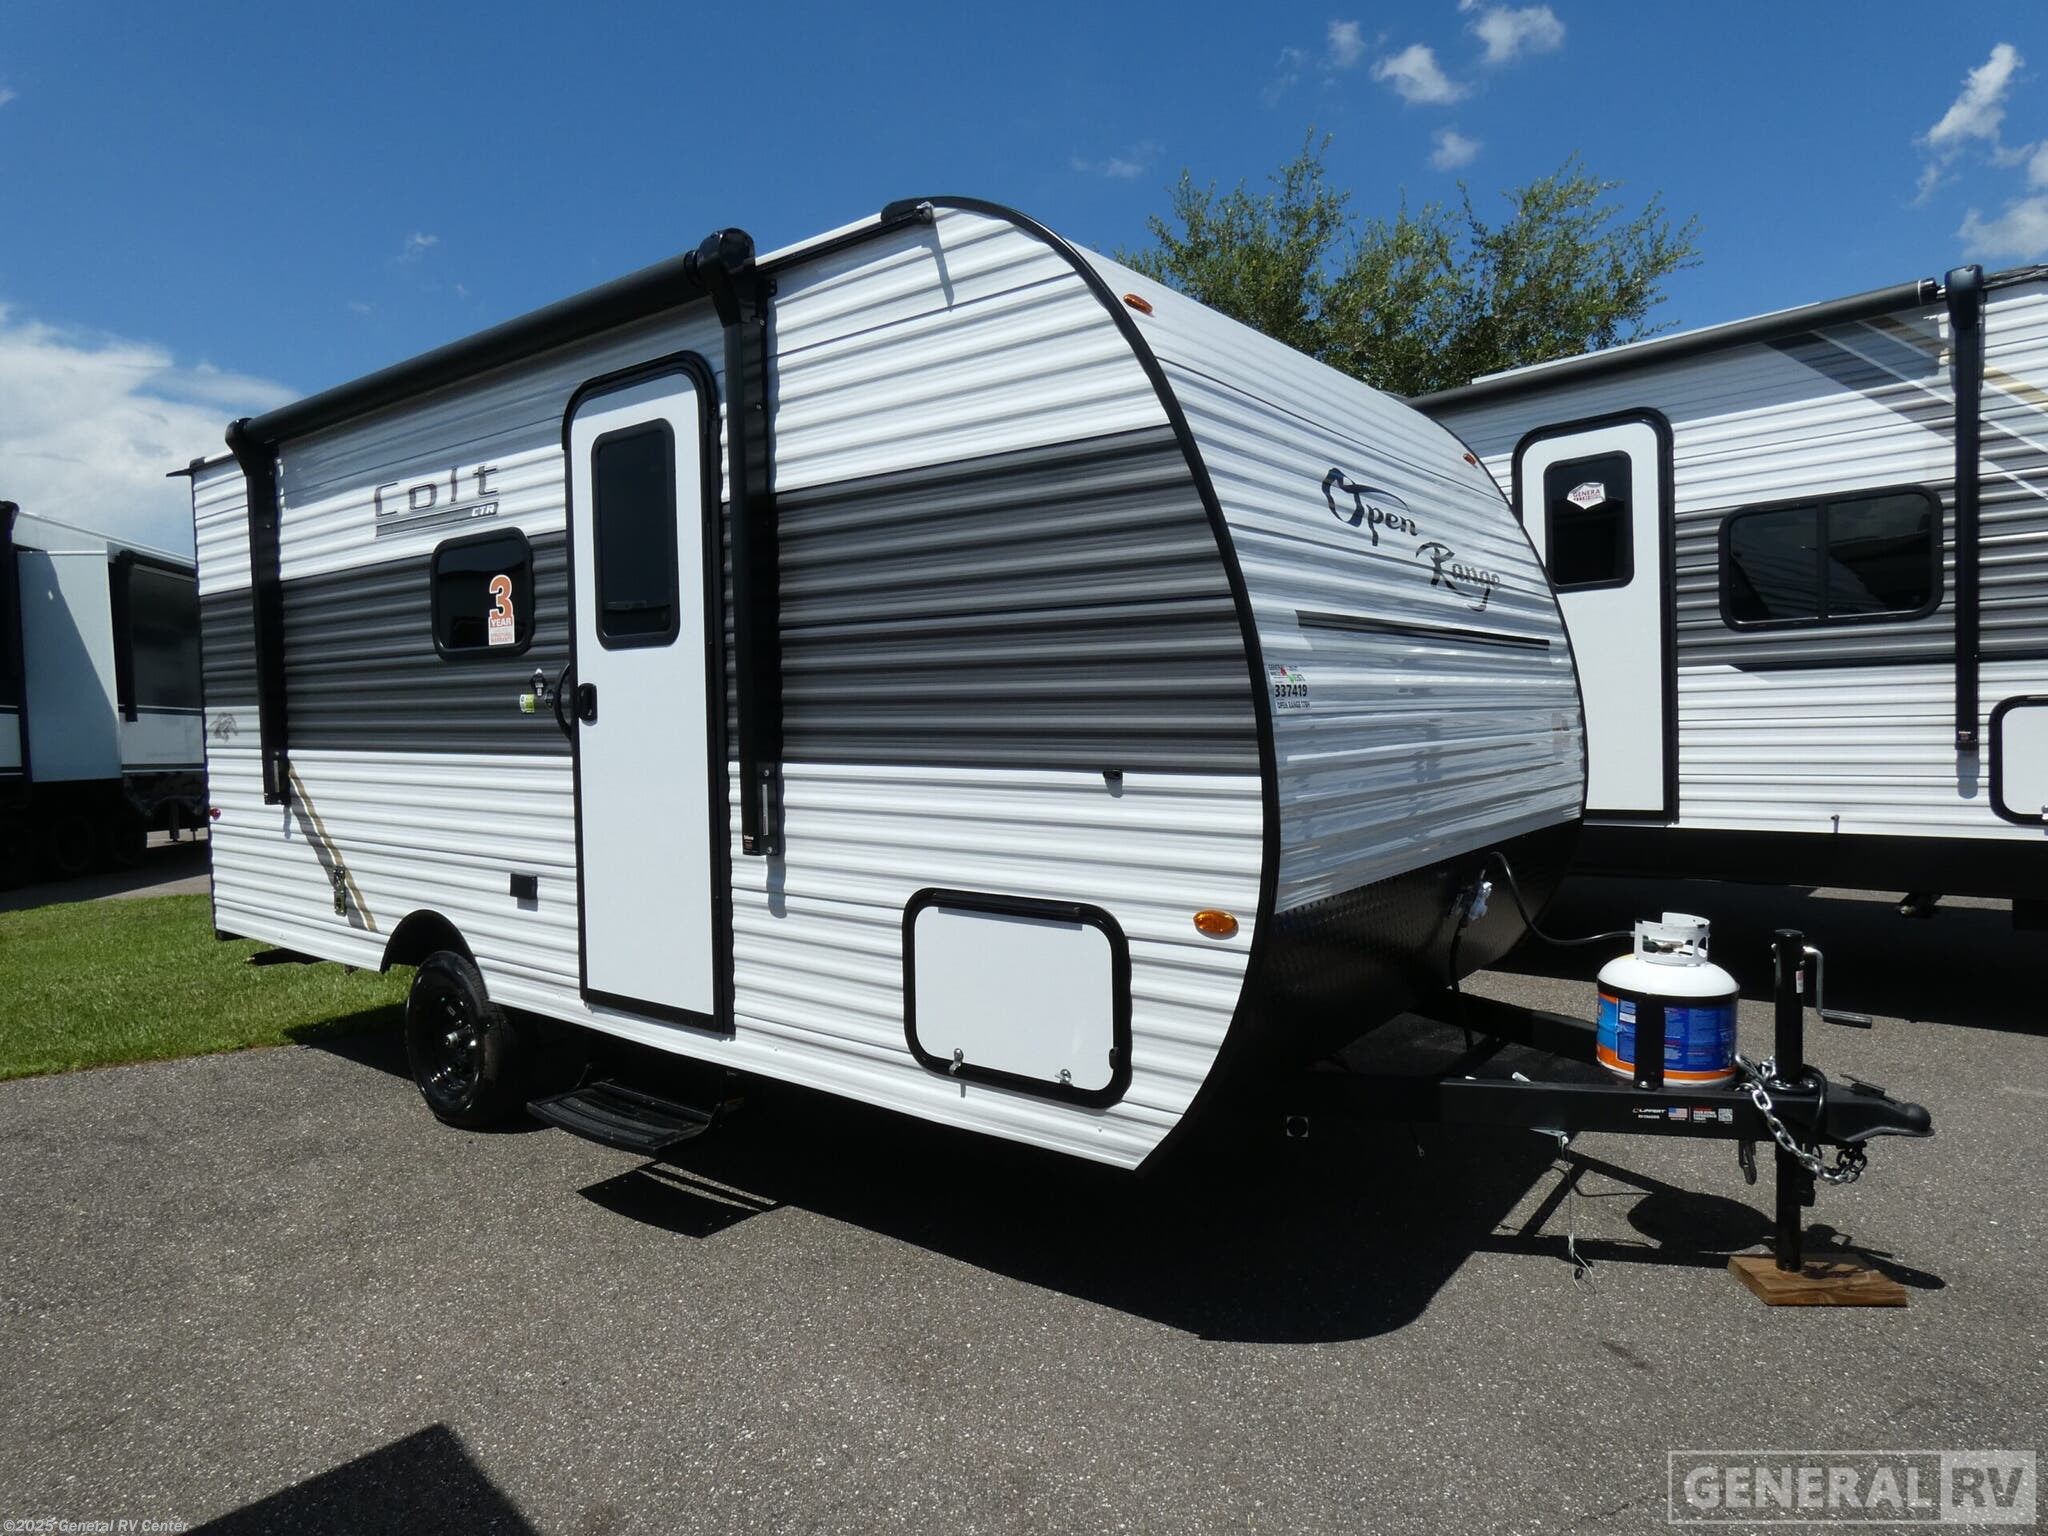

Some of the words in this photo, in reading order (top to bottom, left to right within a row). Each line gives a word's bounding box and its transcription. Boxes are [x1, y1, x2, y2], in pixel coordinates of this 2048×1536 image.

[374, 465, 498, 518] Colt
[471, 504, 495, 517] CTR
[1321, 467, 1418, 547] Open
[488, 574, 514, 618] 3
[1415, 541, 1501, 612] Range
[490, 617, 512, 627] YEAR
[1274, 684, 1308, 698] 337419
